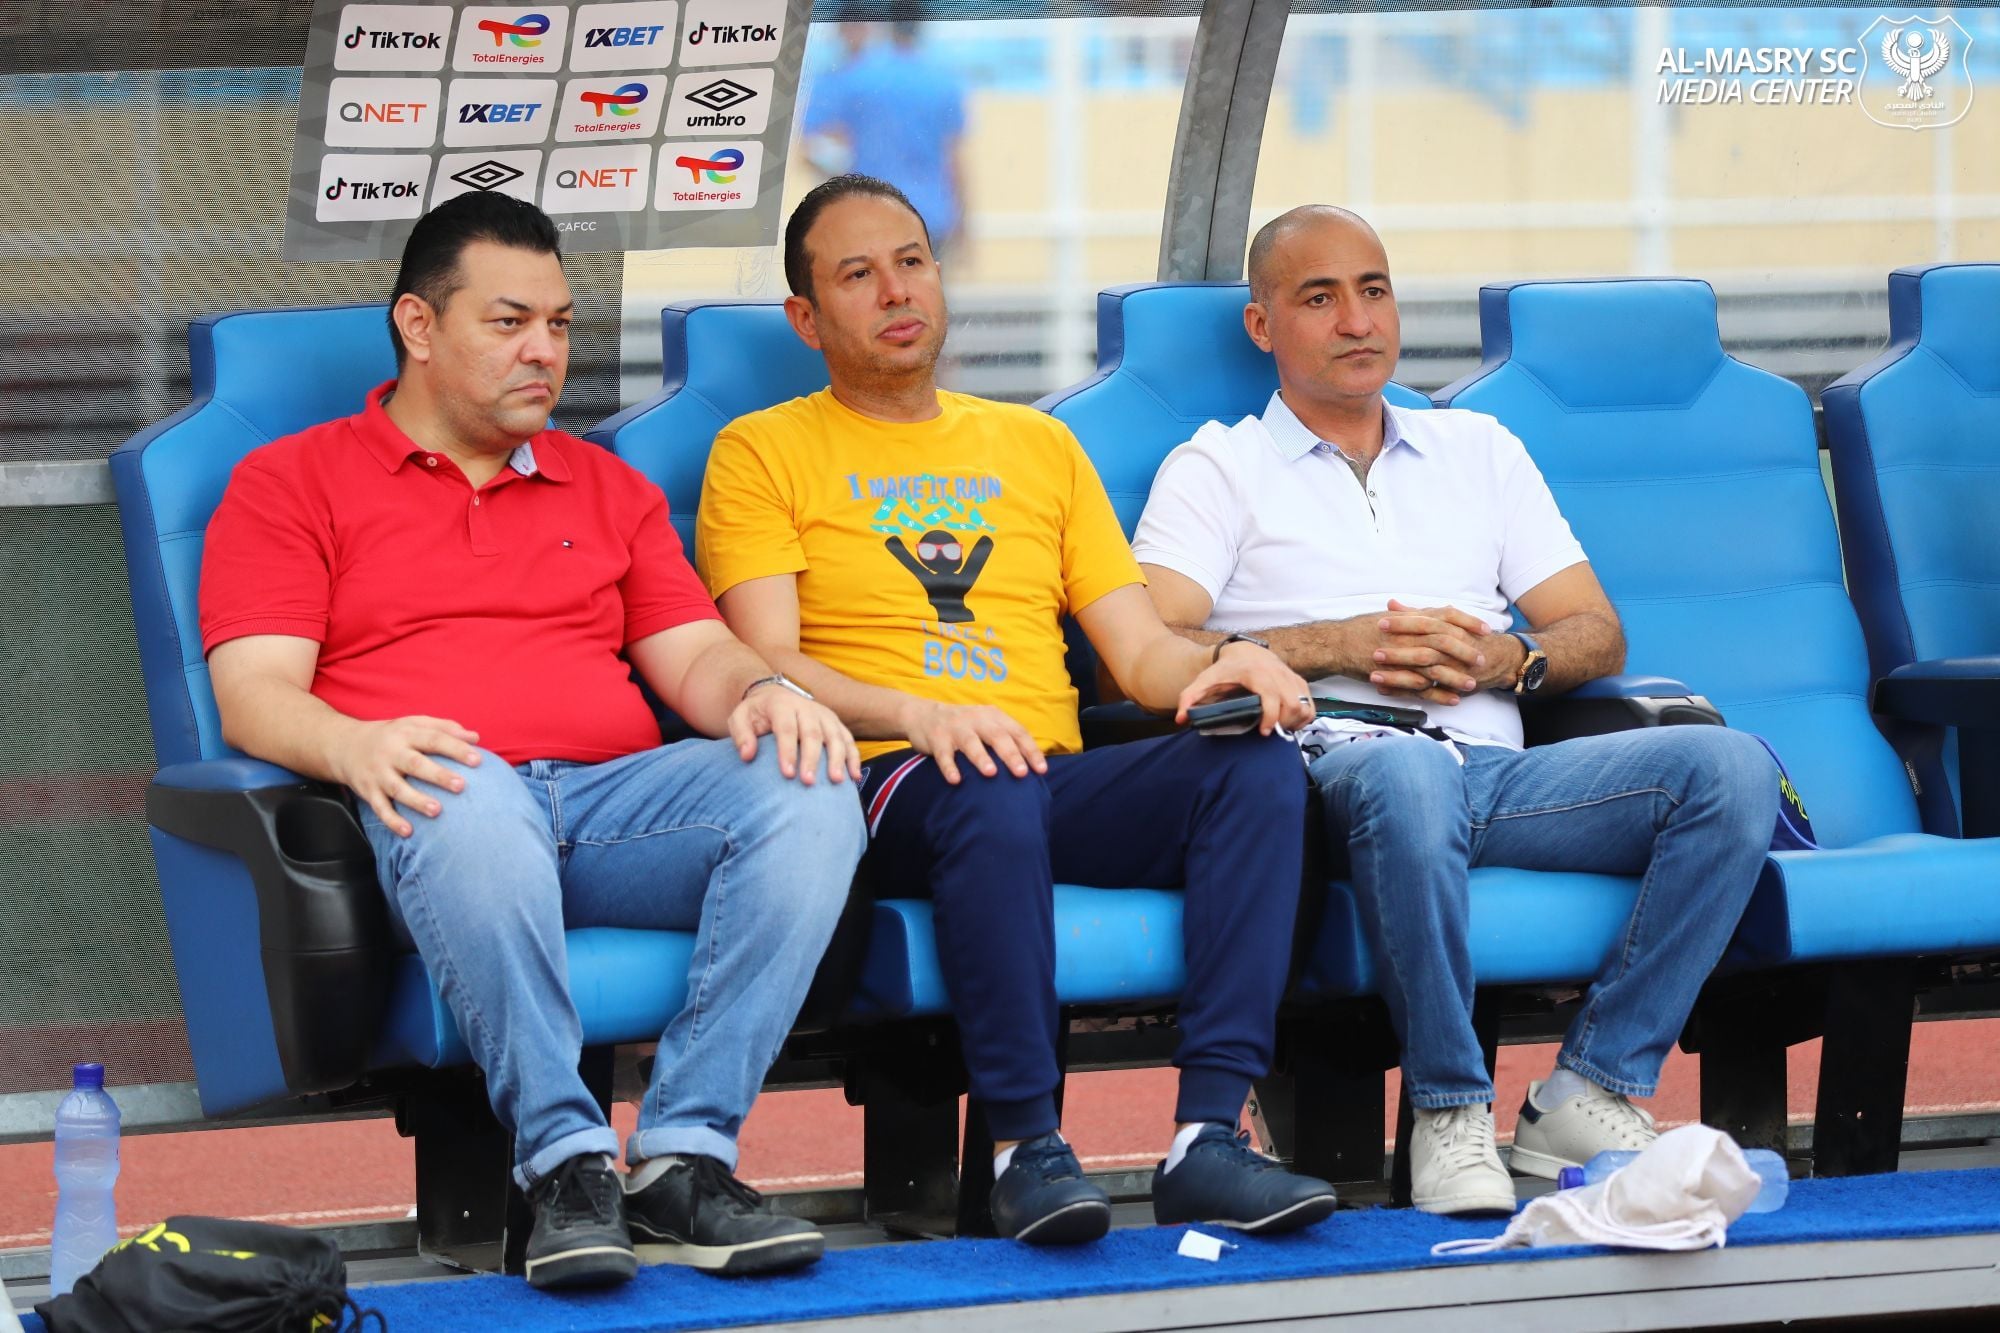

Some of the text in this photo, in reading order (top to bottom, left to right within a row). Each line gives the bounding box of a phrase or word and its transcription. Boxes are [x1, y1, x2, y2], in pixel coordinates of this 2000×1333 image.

[369, 31, 441, 49] TikTok
[584, 25, 664, 48] 1XBET
[712, 24, 778, 44] TikTok
[472, 53, 545, 65] TotalEnergies
[339, 102, 428, 123] QNET
[458, 103, 542, 123] 1XBET
[686, 112, 746, 127] umbro
[574, 122, 641, 133] TotalEnergies
[556, 168, 638, 188] QNET
[350, 181, 420, 200] TikTok
[672, 191, 741, 202] TotalEnergies
[555, 221, 597, 232] CAFCC
[844, 473, 1003, 500] I MAKE IT RAIN
[923, 640, 1008, 682] BOSS
